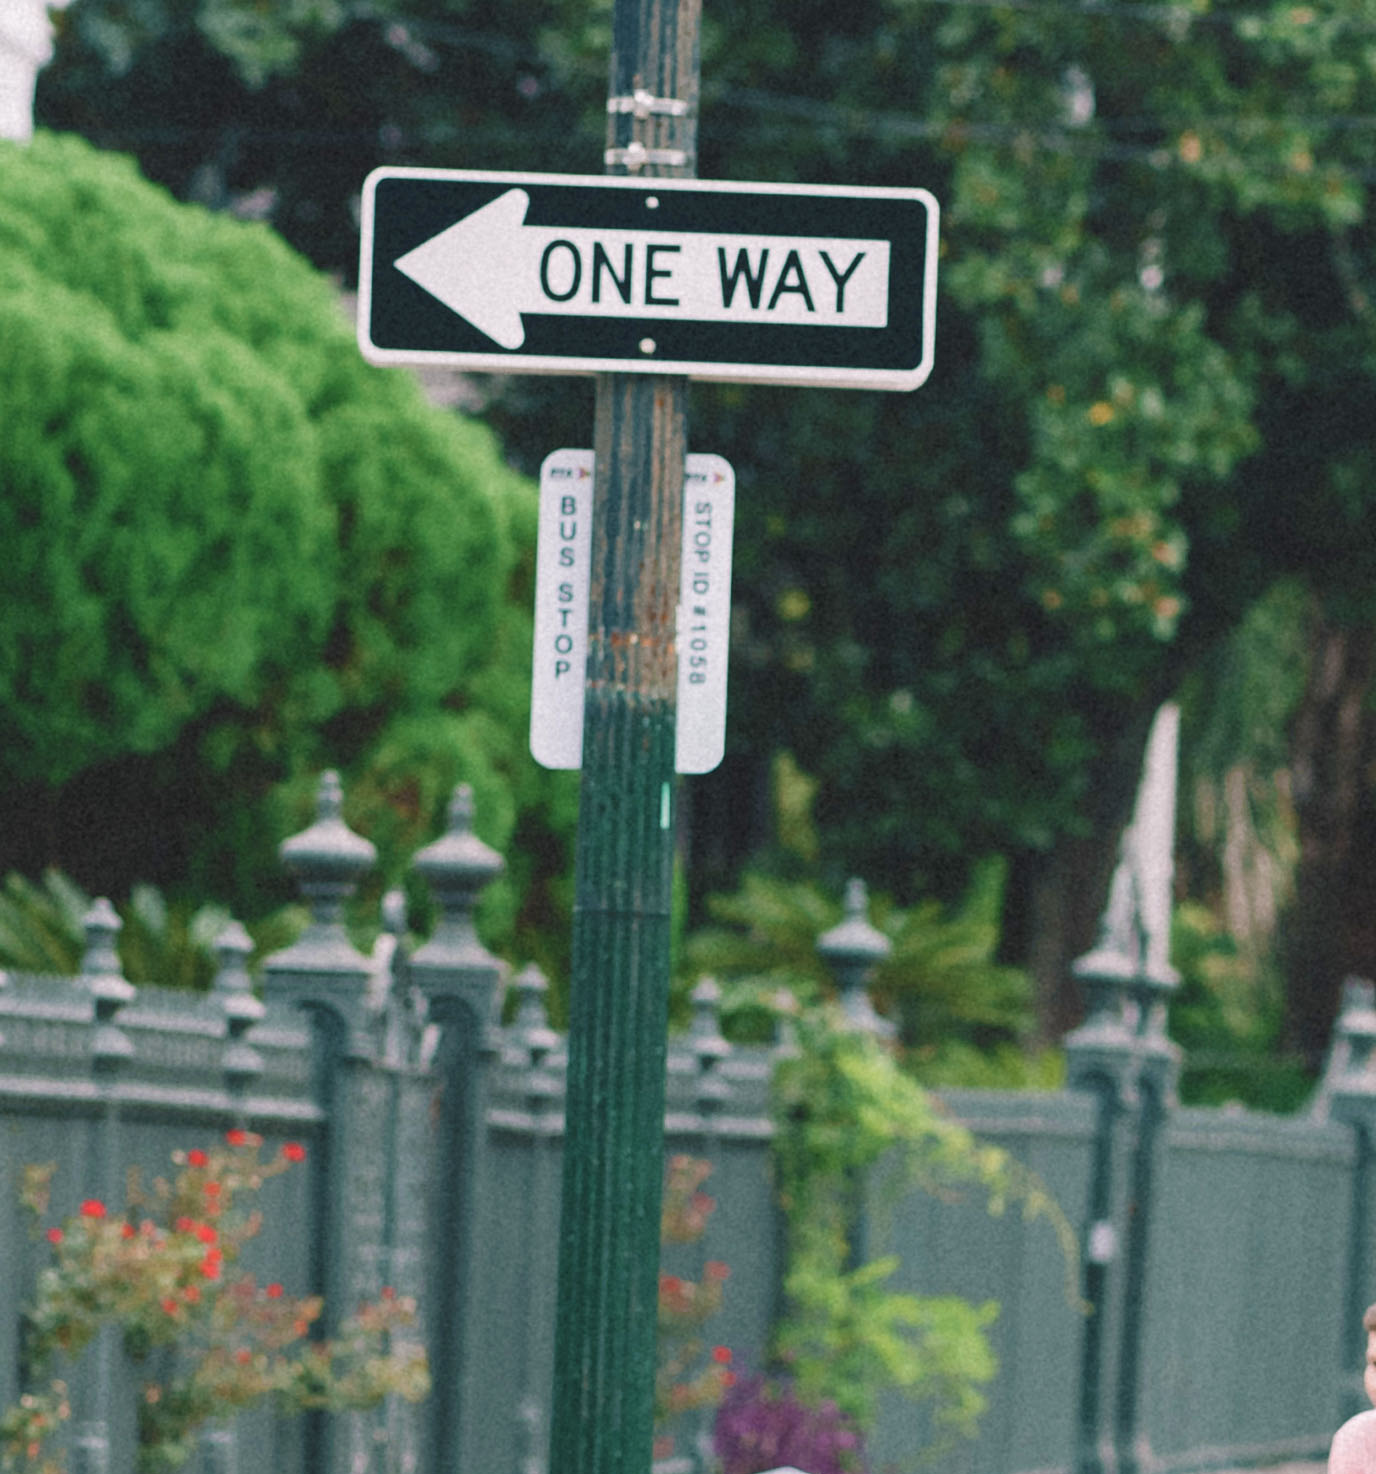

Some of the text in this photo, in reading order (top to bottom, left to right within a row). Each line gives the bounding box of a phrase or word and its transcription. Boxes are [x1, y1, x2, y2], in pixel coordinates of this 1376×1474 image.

[540, 239, 866, 313] ONE WAY
[558, 496, 577, 567] BUS
[693, 502, 712, 563] STOP
[692, 572, 710, 595] ID
[554, 584, 574, 679] STOP
